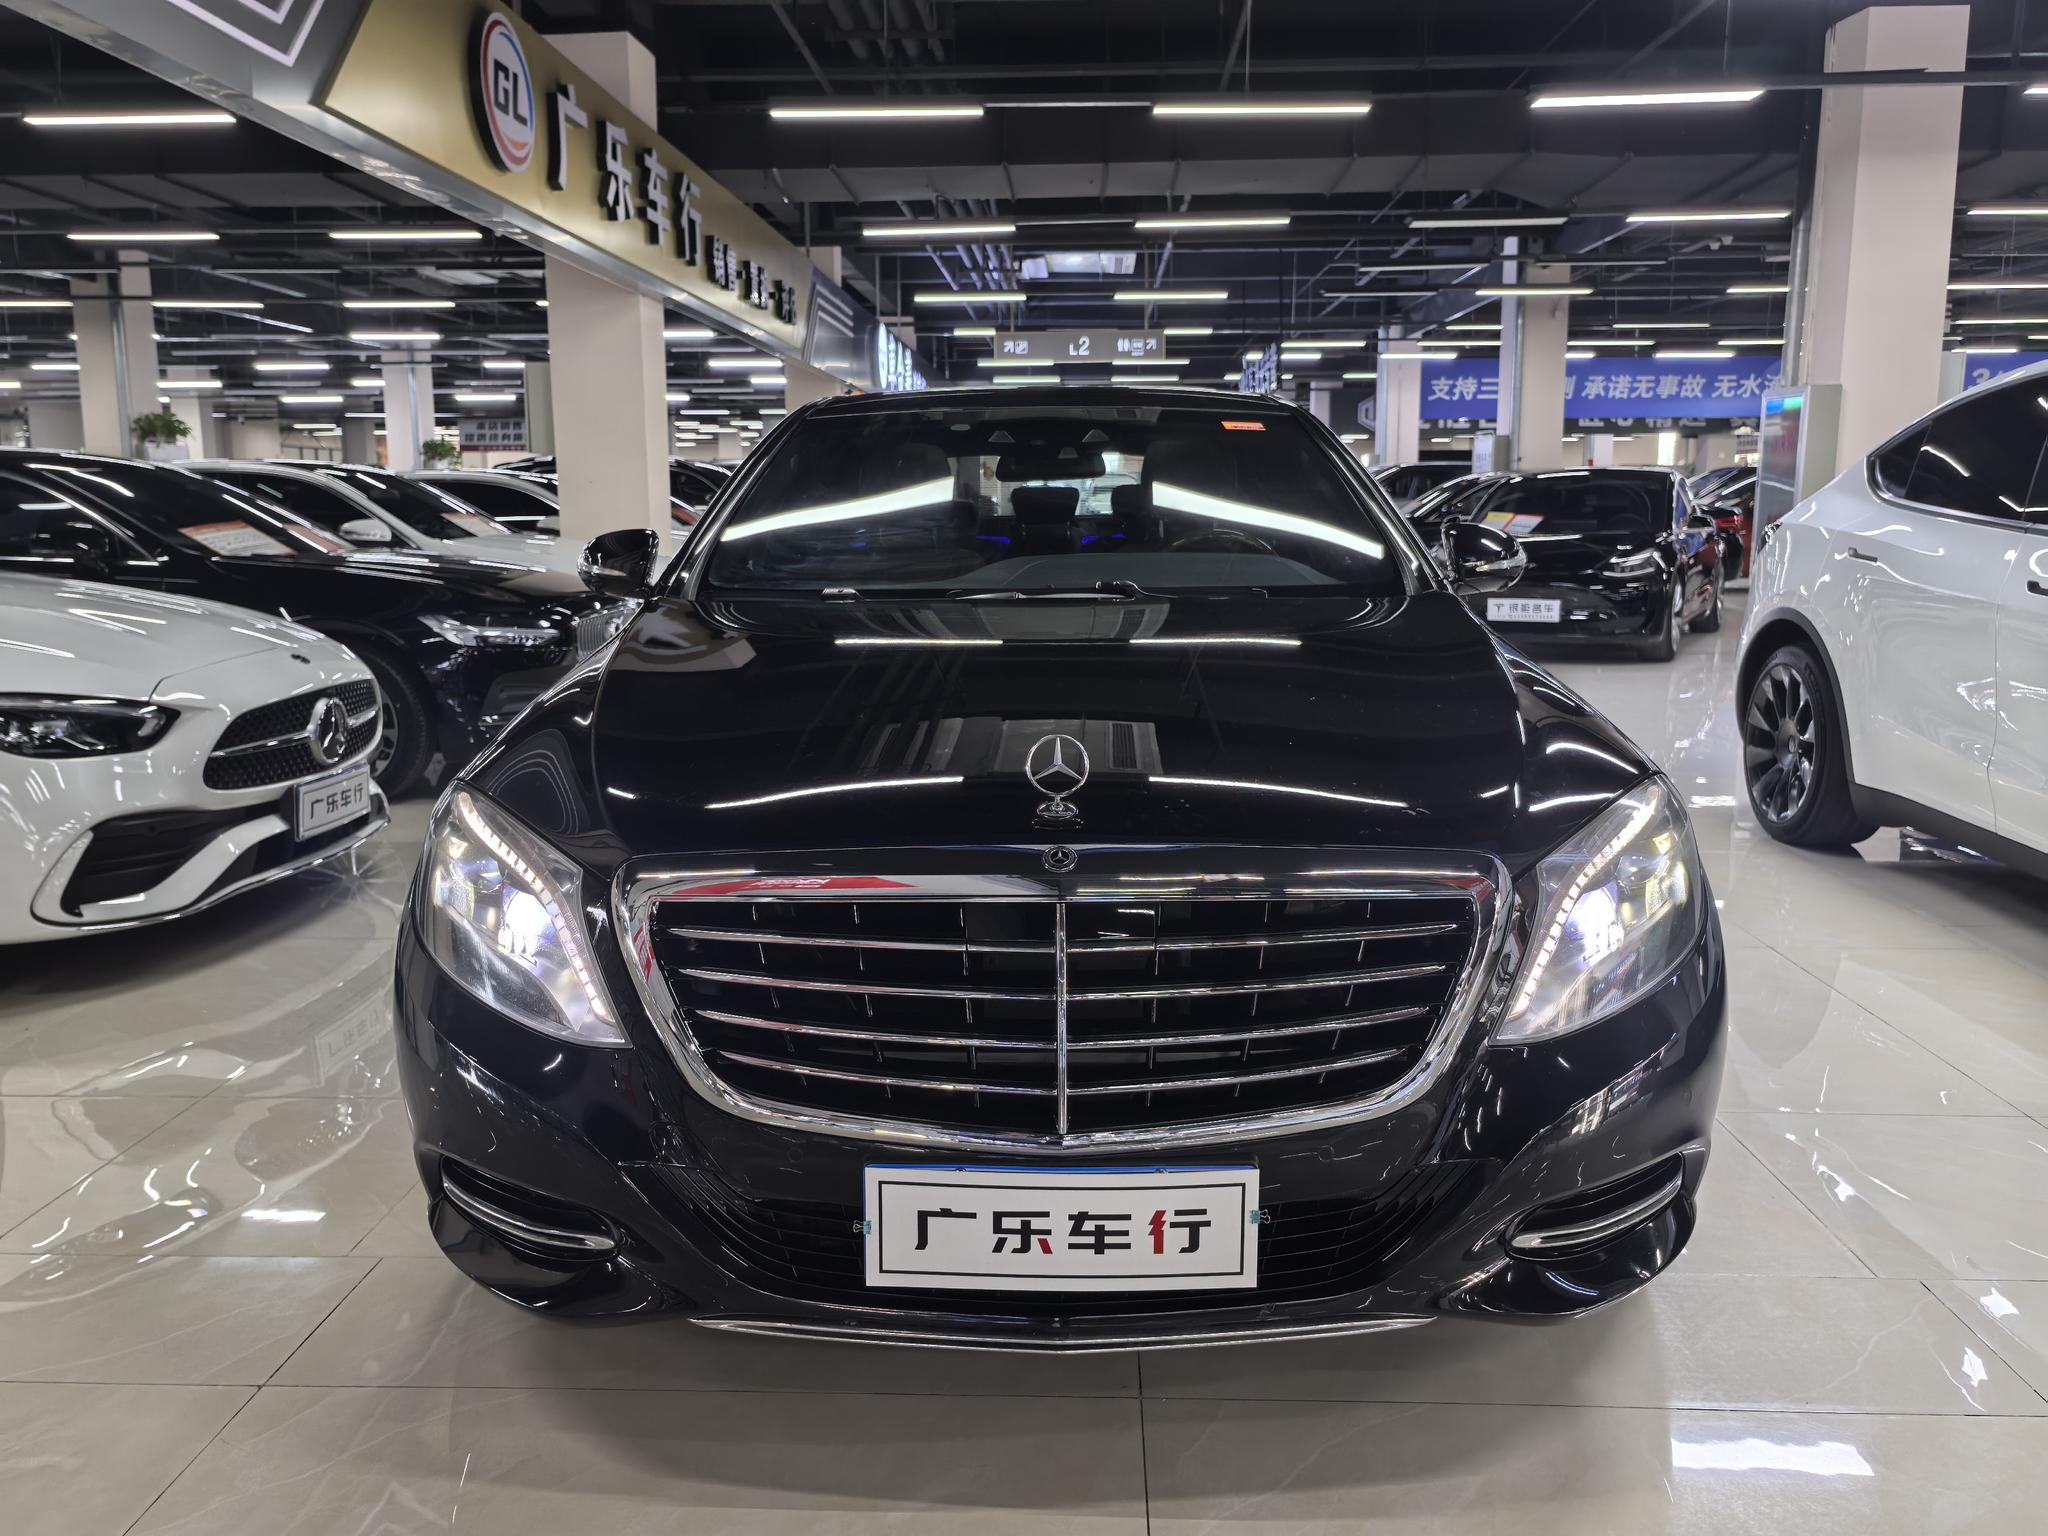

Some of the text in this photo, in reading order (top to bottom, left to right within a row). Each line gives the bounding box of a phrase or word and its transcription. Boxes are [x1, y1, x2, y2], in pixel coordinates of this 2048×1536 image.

[493, 58, 529, 127] GL
[553, 84, 703, 268] 广乐车行
[1069, 335, 1090, 356] L2
[1581, 374, 1707, 400] 承诺无事故
[310, 783, 364, 820] 广乐车行
[914, 1207, 1212, 1256] 广乐车行
